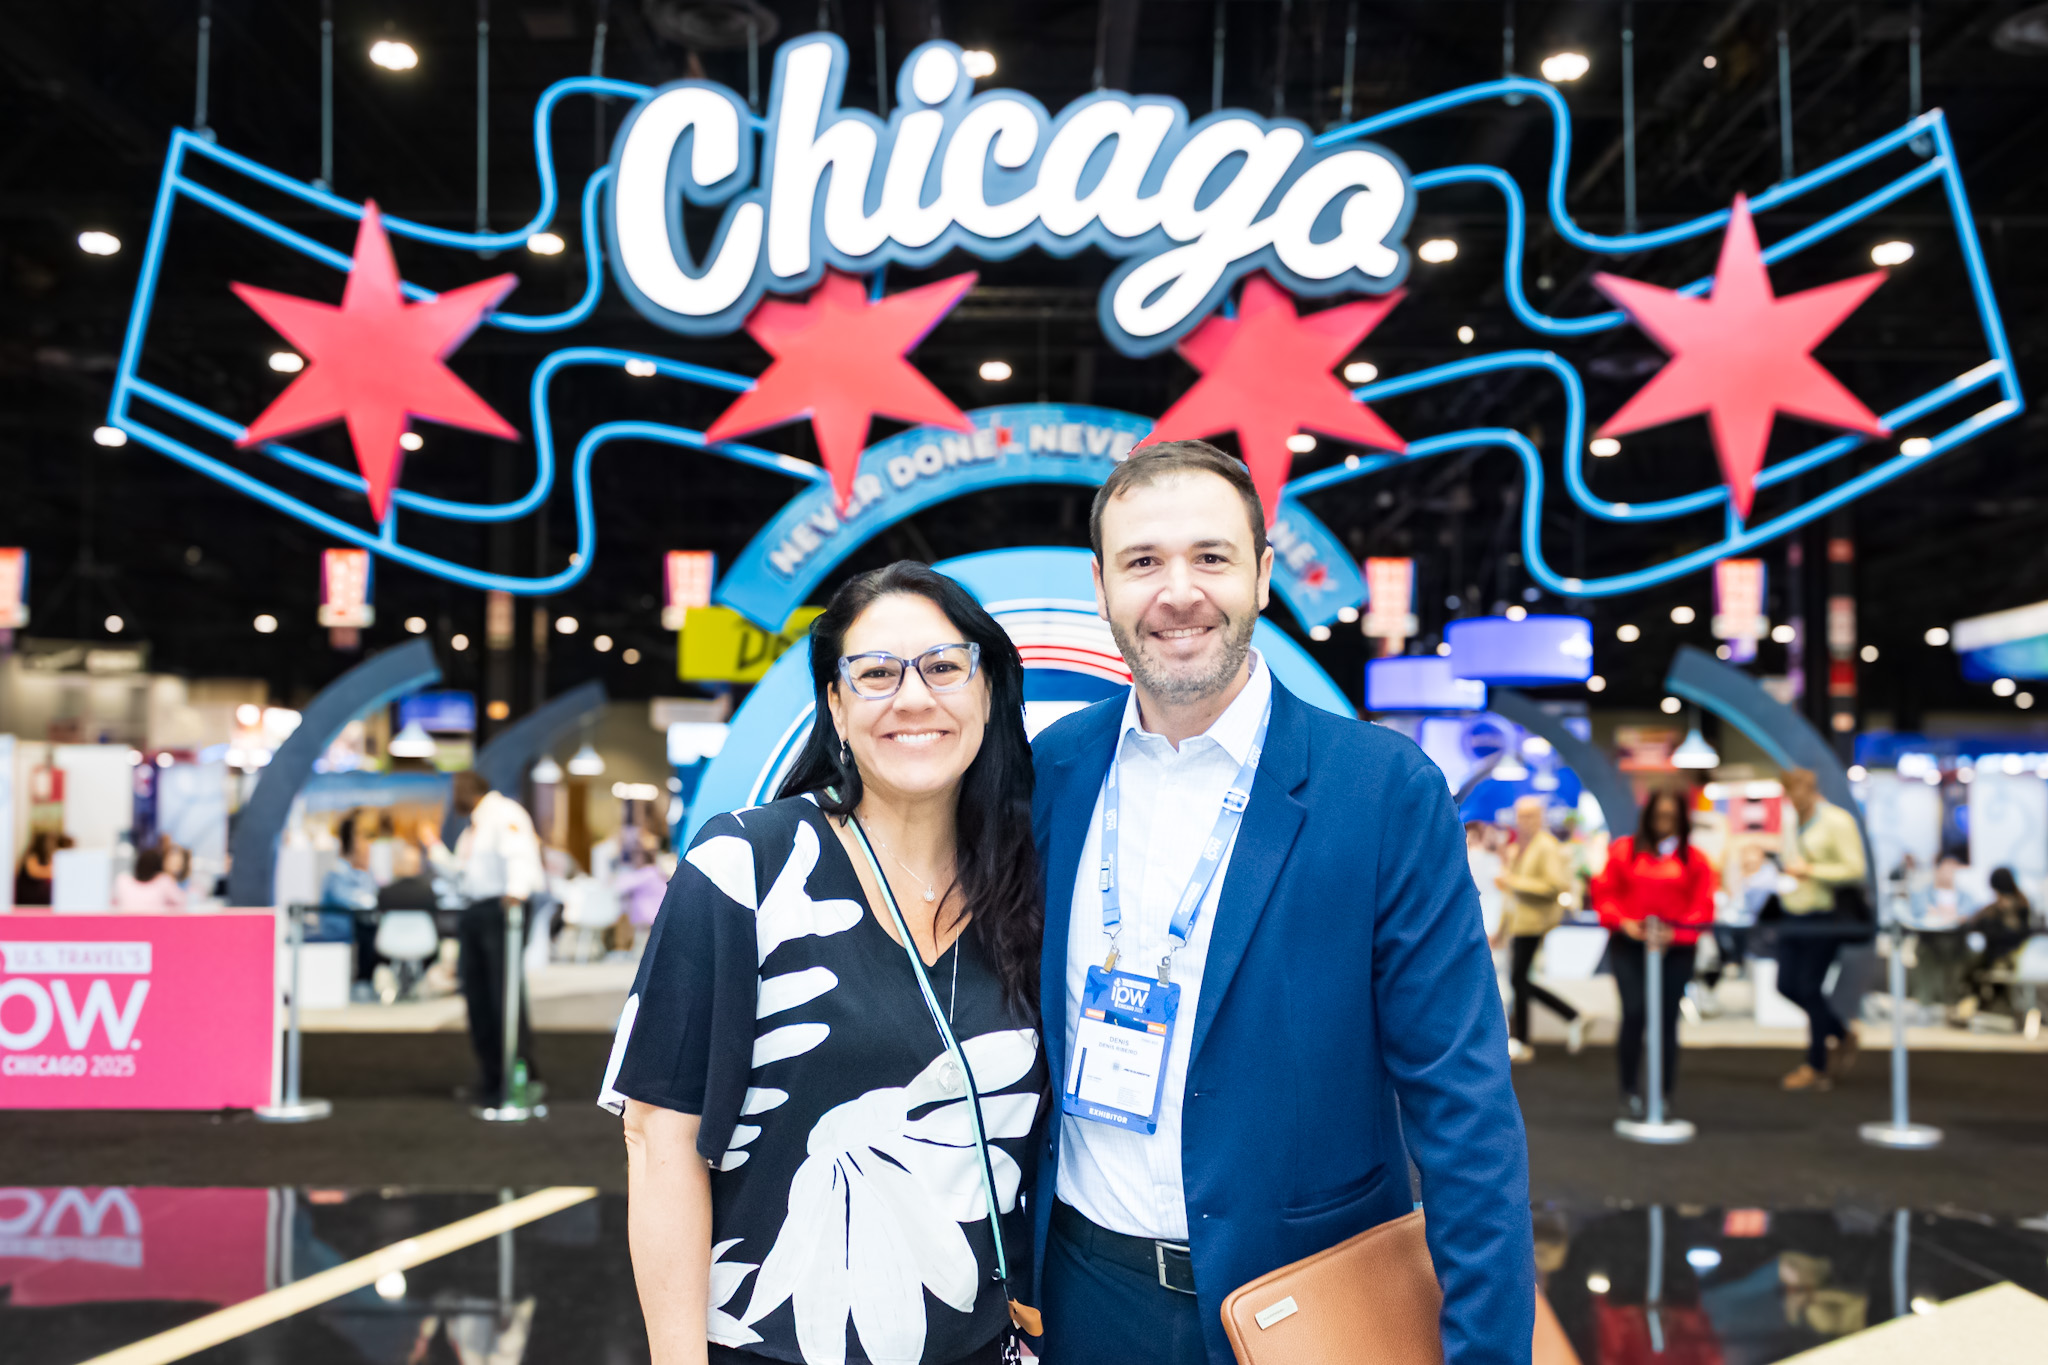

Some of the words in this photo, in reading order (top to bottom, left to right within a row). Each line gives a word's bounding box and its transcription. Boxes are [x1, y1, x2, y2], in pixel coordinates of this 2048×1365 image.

[614, 40, 1406, 338] Chicago
[768, 473, 883, 575] NEVR
[1029, 421, 1136, 462] NEVE
[1109, 1036, 1130, 1047] DENIS
[2, 1054, 88, 1077] CHICAGO
[90, 1054, 137, 1077] 2025
[1088, 1107, 1128, 1125] EXHIBITOR
